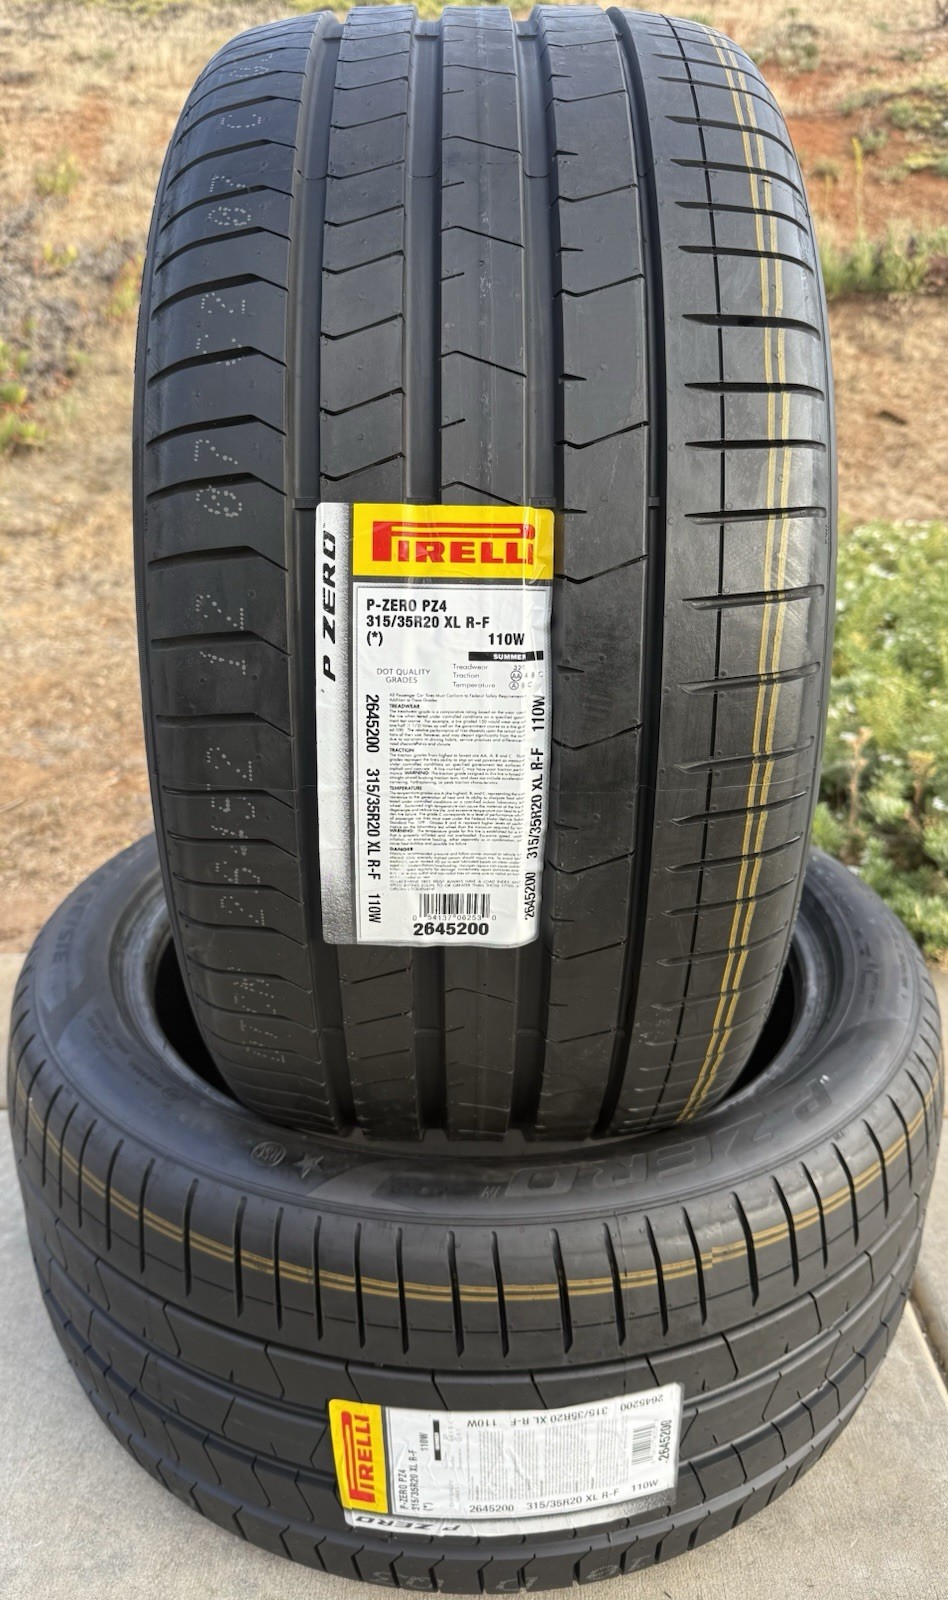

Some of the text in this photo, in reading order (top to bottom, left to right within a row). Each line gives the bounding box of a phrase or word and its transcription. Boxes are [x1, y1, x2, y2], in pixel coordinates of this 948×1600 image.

[371, 521, 536, 565] PIRELLI
[322, 530, 337, 682] P ZERO
[366, 598, 447, 613] P-ZERO PZ4
[366, 615, 490, 629] 315/35R20 XL R-F
[488, 633, 526, 646] 110W
[376, 667, 431, 677] DOT QUALITY
[452, 663, 489, 671] Treadwear
[452, 671, 480, 679] Traction
[385, 675, 418, 684] GRADES
[452, 681, 496, 690] Temperature
[532, 695, 545, 732] 110W
[530, 747, 544, 771] R-F
[532, 773, 543, 791] XL
[365, 694, 382, 924] 2645200 315/35R20 XL R-F 110W
[526, 794, 543, 860] 315/35R20
[413, 922, 490, 936] 2645200
[467, 1394, 664, 1428] 2645200 315/35R20 XL R-F 110W
[419, 1431, 429, 1451] 110W
[340, 1411, 376, 1505] PIRELLI
[397, 1469, 409, 1510] P-ZERO PZ4
[408, 1449, 420, 1511] 315/35R20 XL R-F
[468, 1478, 659, 1514] 2645200 315/35R20 XL R-F 110W
[354, 1515, 461, 1532] P ZERO
